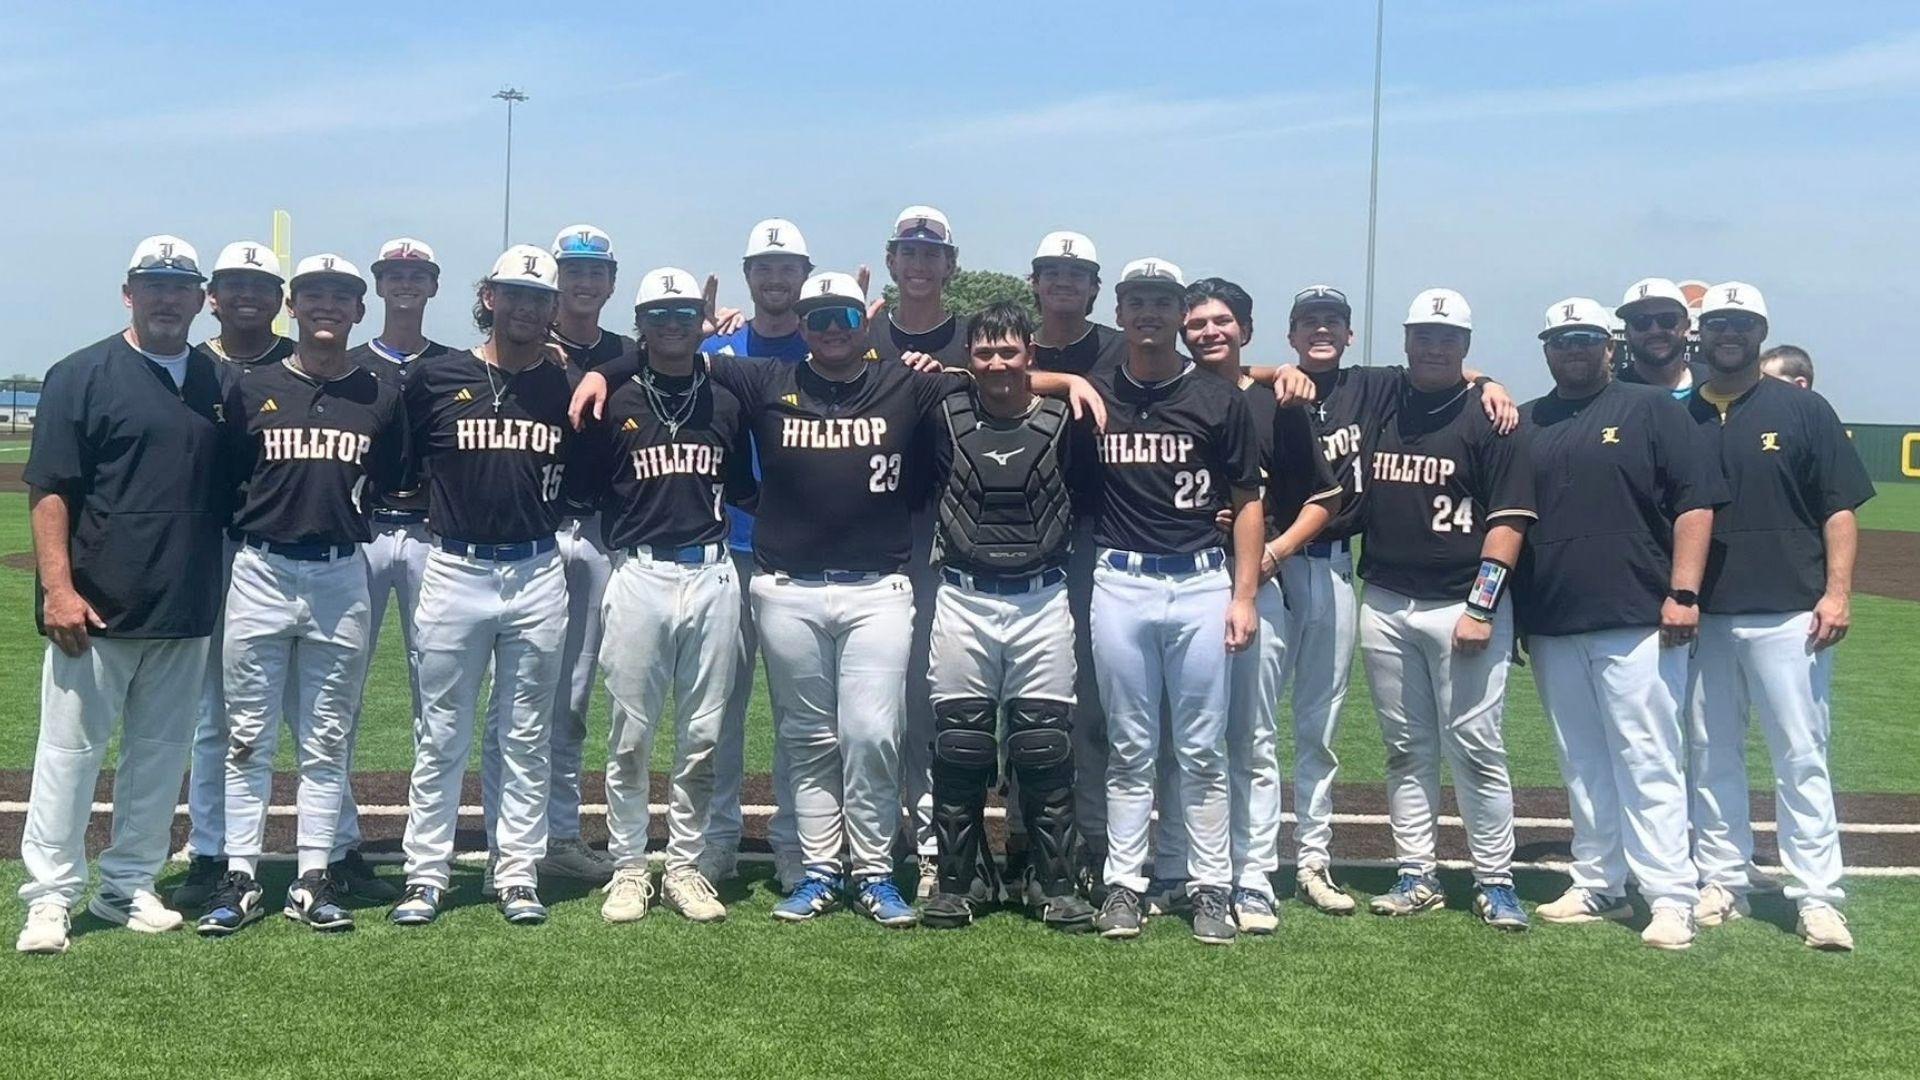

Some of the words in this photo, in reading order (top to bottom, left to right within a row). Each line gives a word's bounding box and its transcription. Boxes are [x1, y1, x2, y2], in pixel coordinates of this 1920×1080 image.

[766, 227, 785, 247] L
[1060, 239, 1078, 260] L
[244, 247, 263, 266] L
[522, 255, 542, 278] L
[660, 275, 682, 295] L
[1724, 288, 1744, 305] L
[1431, 297, 1449, 317] L
[1561, 304, 1582, 321] L
[262, 428, 371, 465] HILLTOP
[457, 418, 562, 455] HILLTOP
[782, 417, 887, 448] HILLTOP
[1601, 427, 1620, 443] L
[1760, 432, 1780, 450] L
[630, 443, 724, 480] HILLTOP
[1096, 433, 1194, 463] HILLTOP
[542, 464, 565, 502] 15
[869, 453, 902, 493] 23
[1352, 455, 1363, 493] 1
[712, 483, 724, 522] 7
[1174, 468, 1211, 509] 22
[1432, 494, 1473, 533] 24
